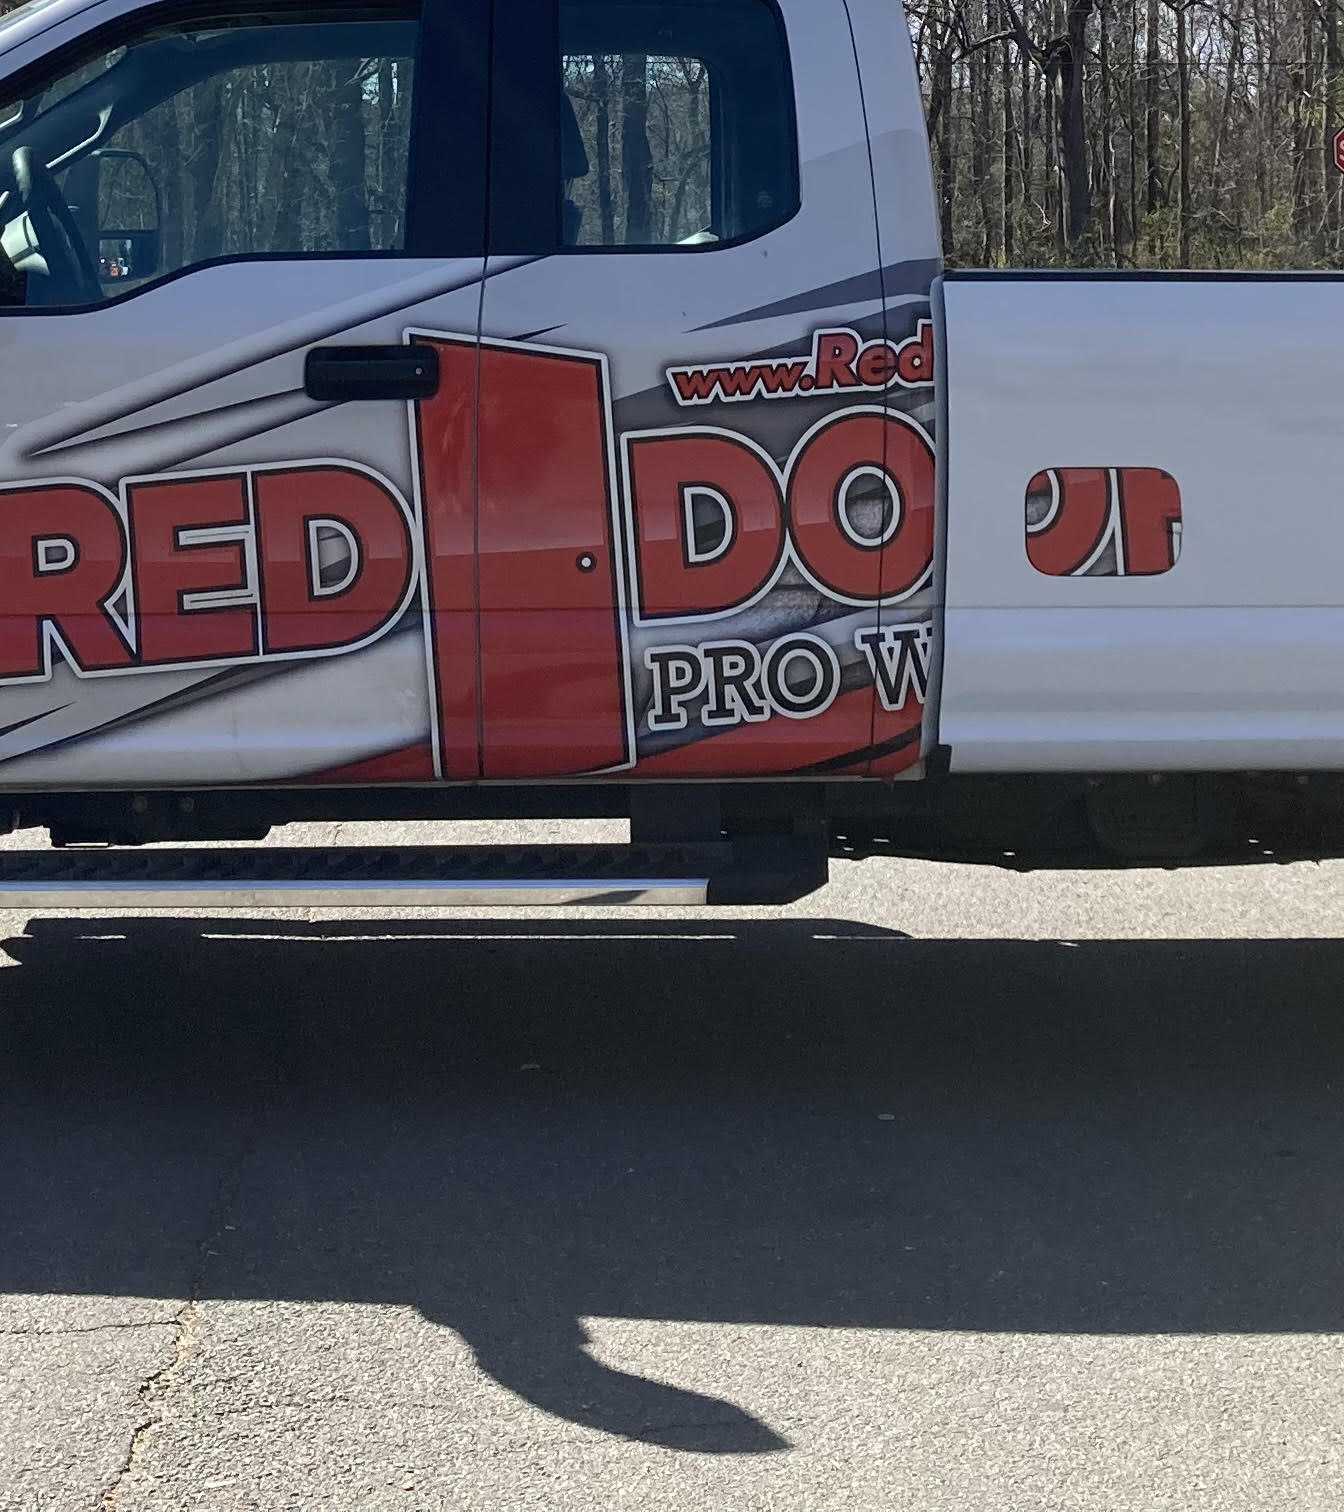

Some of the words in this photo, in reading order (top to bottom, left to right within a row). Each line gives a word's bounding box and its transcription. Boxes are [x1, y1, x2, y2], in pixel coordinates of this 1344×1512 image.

[666, 318, 935, 407] www.Red
[620, 404, 935, 626] DO
[644, 630, 841, 731] PRO
[855, 622, 933, 711] W
